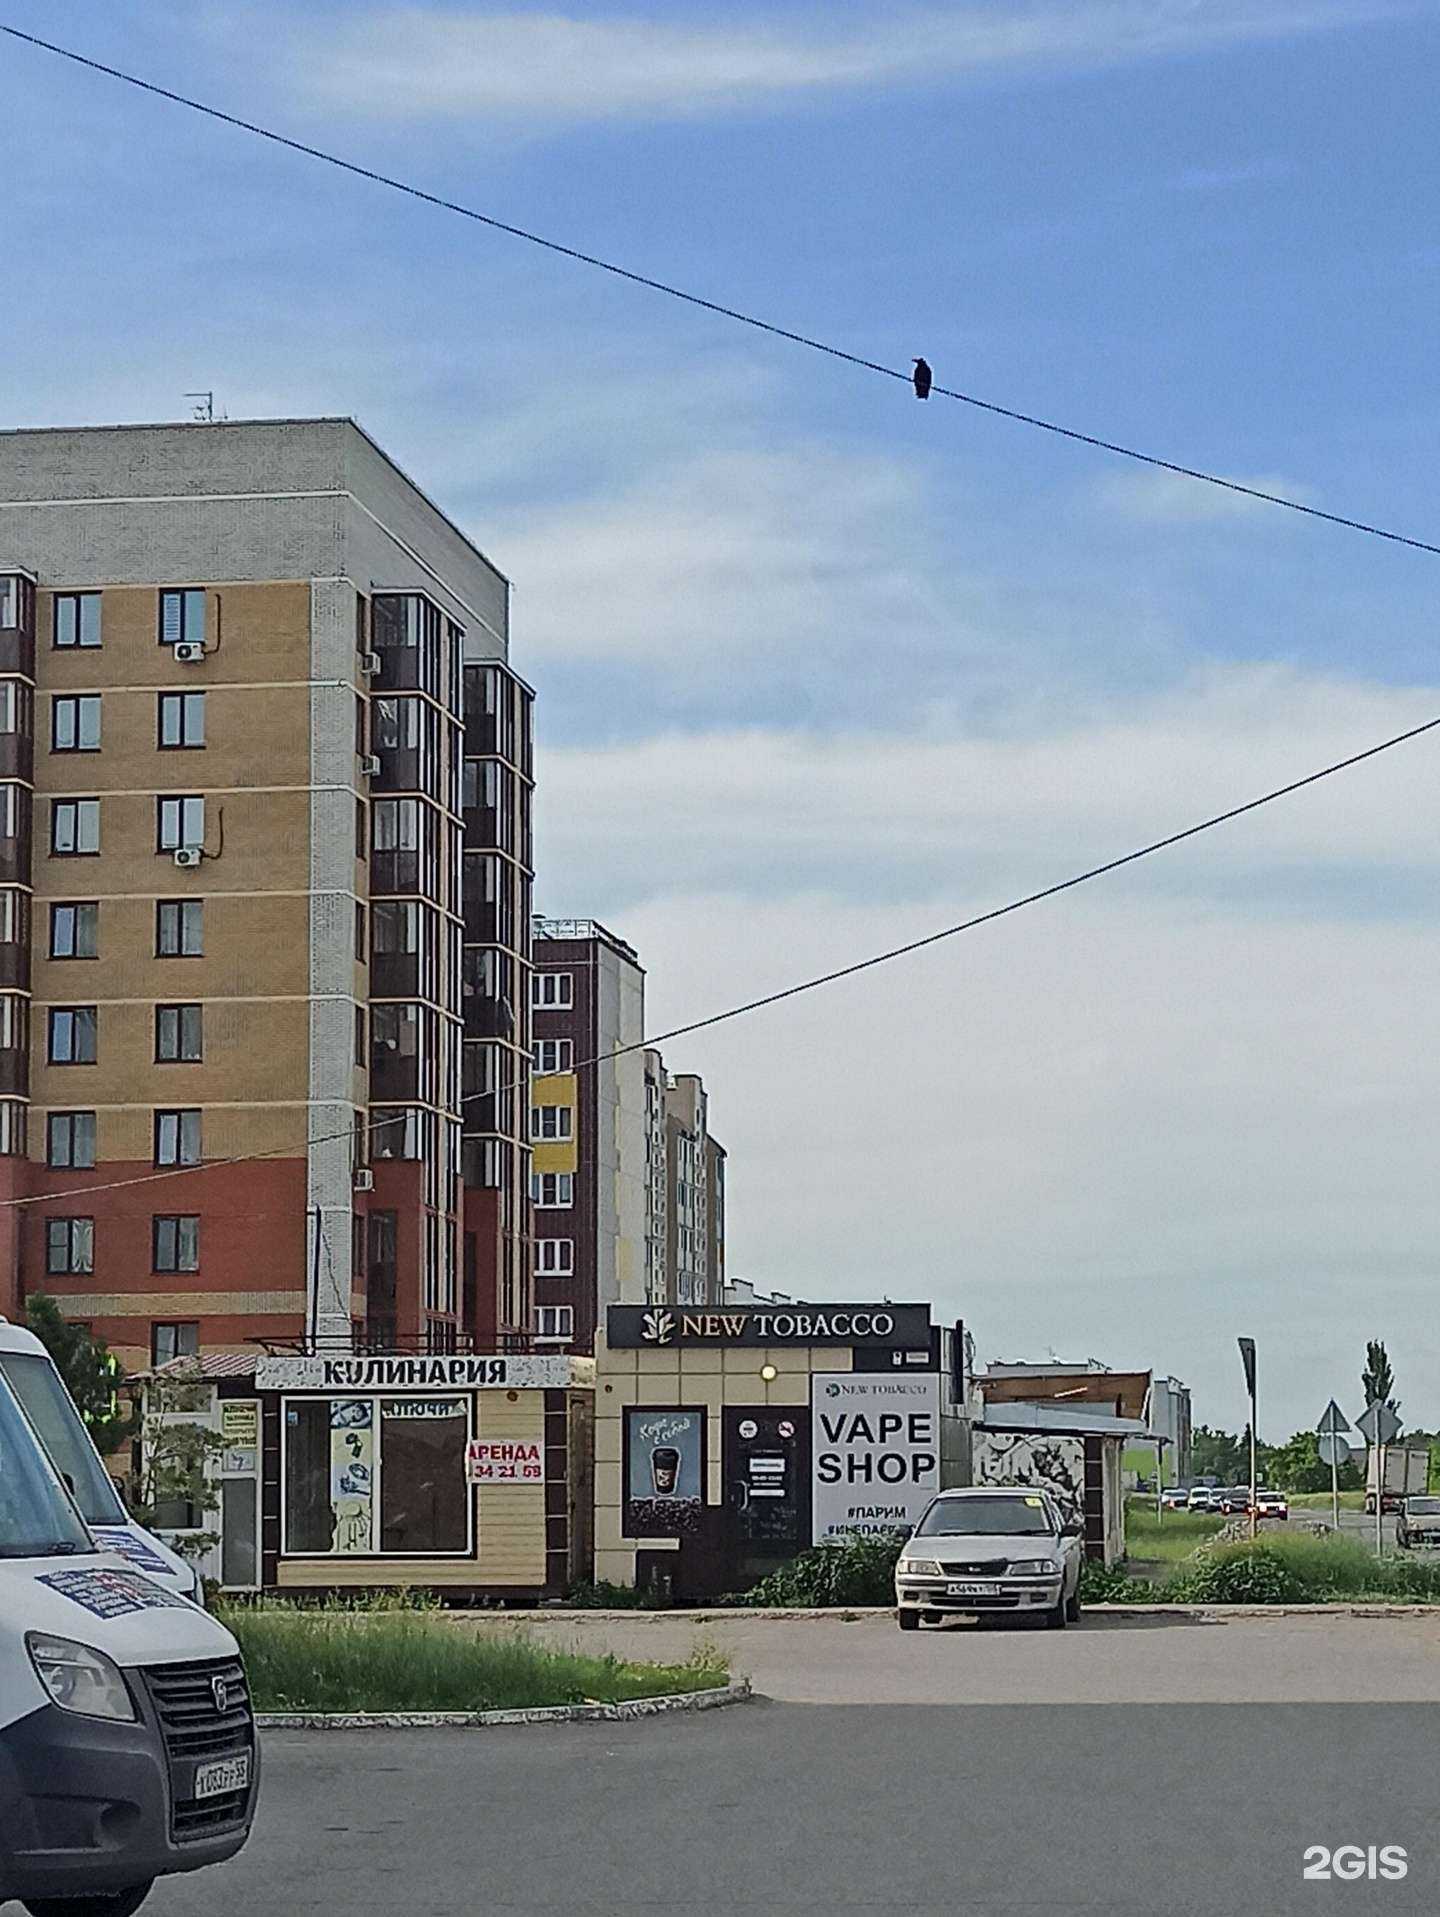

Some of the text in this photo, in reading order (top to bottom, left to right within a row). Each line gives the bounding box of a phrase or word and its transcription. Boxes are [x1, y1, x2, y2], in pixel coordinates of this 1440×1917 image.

[682, 1314, 895, 1337] NEW TOBACCO
[323, 1359, 507, 1384] КУЛИНАРИЯ
[841, 1384, 927, 1395] NEW TOBACCO
[819, 1412, 934, 1445] VAPE
[468, 1444, 540, 1462] АРЕНДА
[817, 1452, 937, 1485] SHOP
[847, 1506, 906, 1519] #ПАРИМ
